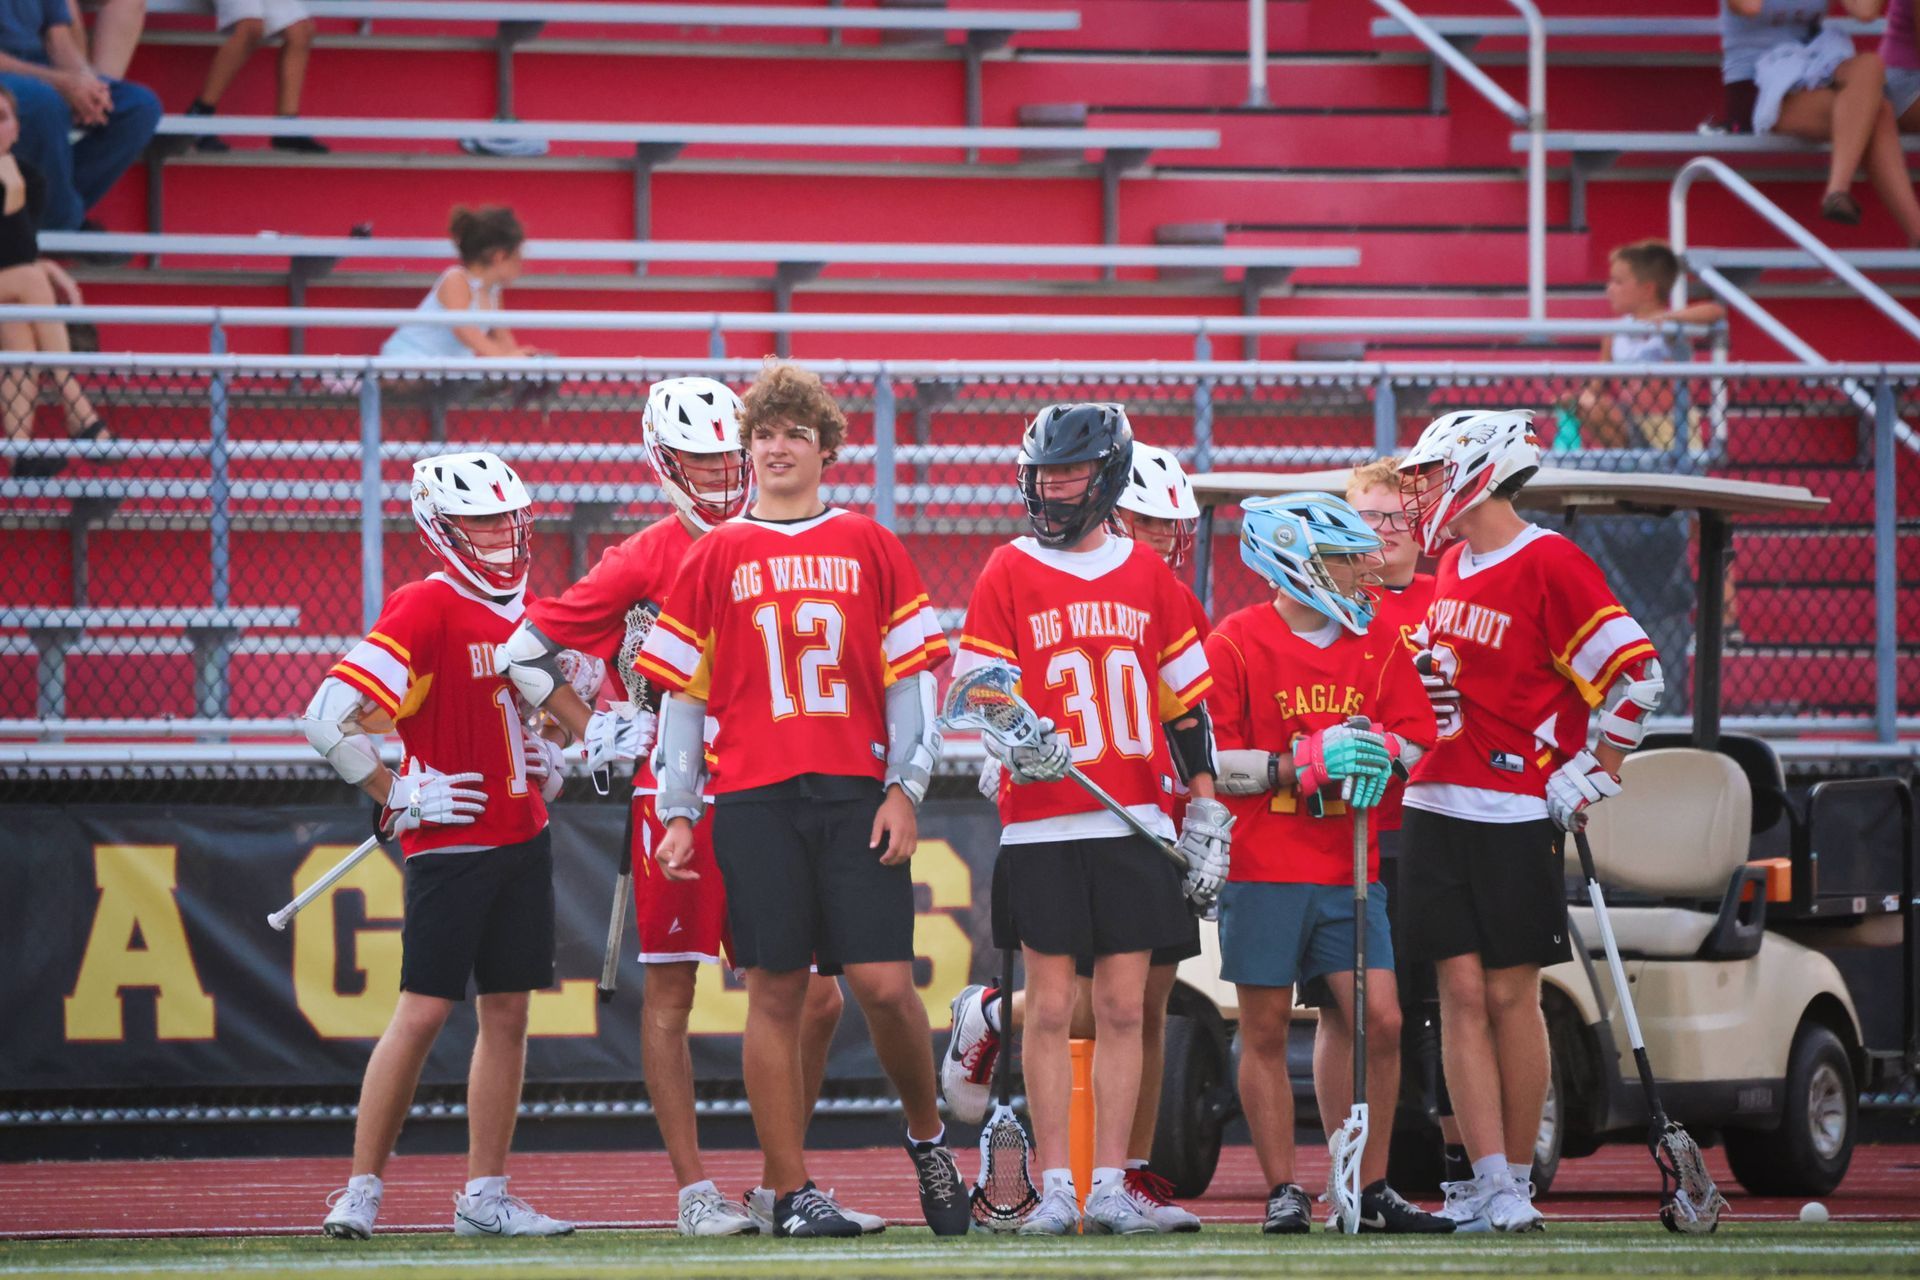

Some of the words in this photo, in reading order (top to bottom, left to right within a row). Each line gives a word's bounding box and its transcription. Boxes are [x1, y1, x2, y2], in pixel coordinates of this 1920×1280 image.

[732, 561, 763, 603] BIG
[767, 555, 861, 595] WALNUT
[1029, 609, 1063, 650] BIG
[1066, 601, 1151, 646] WALNUT
[467, 643, 497, 678] BI
[752, 598, 850, 722] 12
[1044, 645, 1154, 767] 30
[1274, 684, 1365, 720] EAGLES
